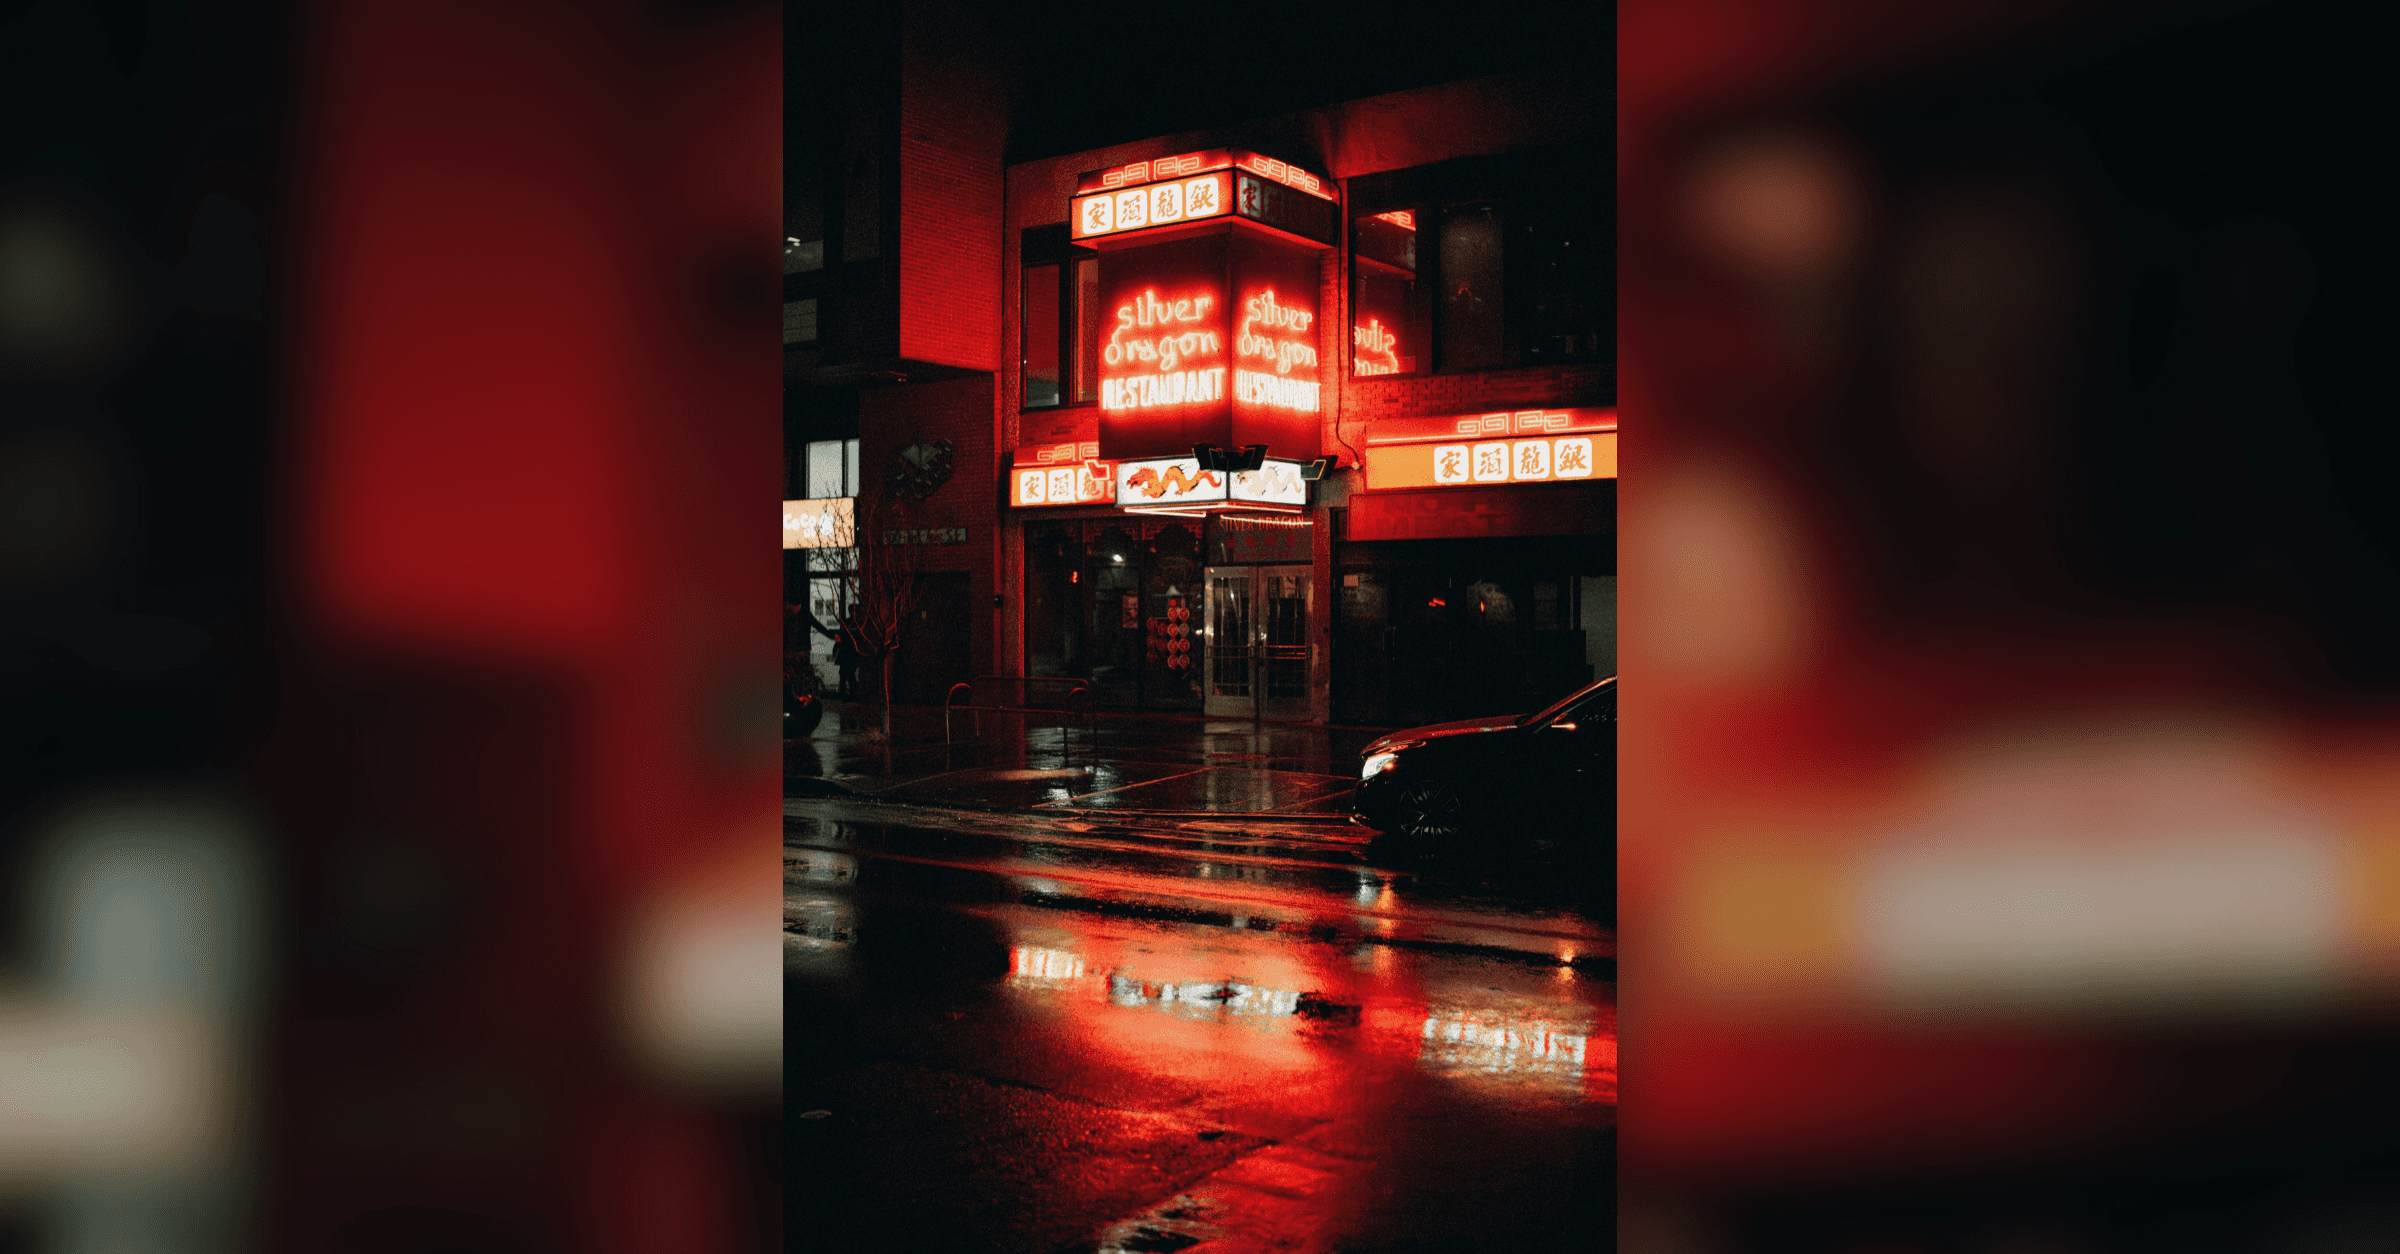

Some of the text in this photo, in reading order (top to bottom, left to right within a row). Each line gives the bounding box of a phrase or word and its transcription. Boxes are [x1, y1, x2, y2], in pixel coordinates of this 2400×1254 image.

[1117, 290, 1213, 328] silver
[1249, 289, 1314, 331] silver
[1105, 328, 1220, 371] dragon
[1238, 328, 1318, 374] dragon
[1102, 368, 1226, 410] RESTAURANT
[1236, 369, 1321, 412] RESTAURANT
[1258, 516, 1304, 530] DRAGON
